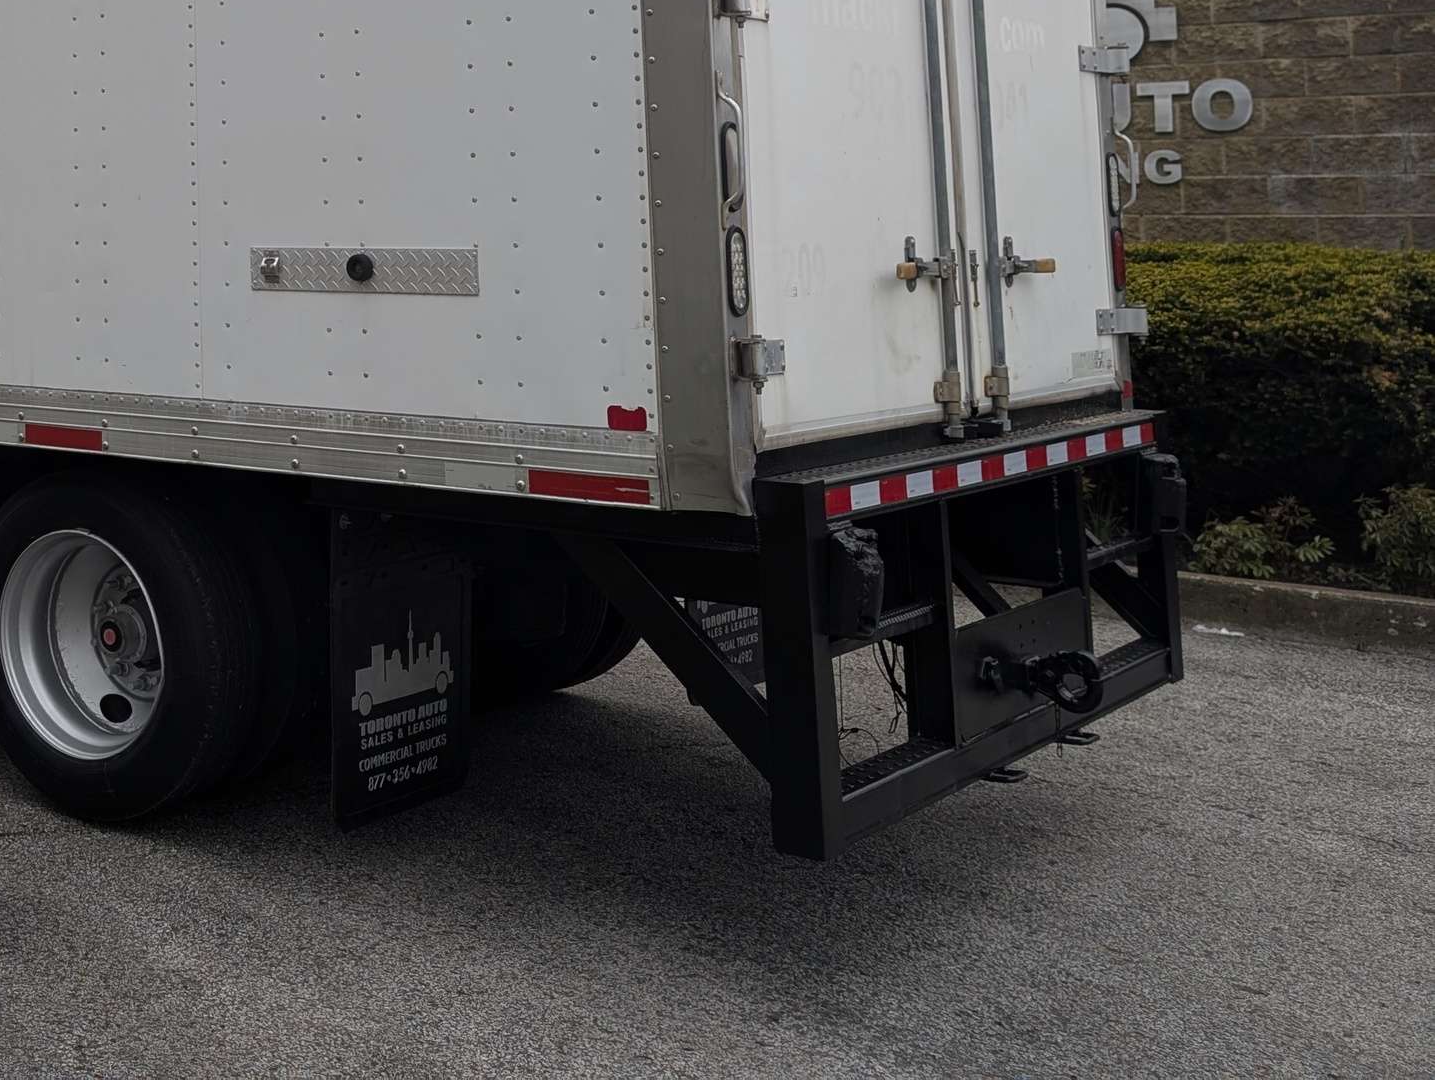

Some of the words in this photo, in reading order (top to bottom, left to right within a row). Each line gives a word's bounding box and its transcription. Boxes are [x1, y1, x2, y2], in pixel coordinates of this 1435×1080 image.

[359, 707, 416, 737] TORONTO
[418, 698, 447, 720] AUTO
[360, 731, 394, 751] SALES
[397, 727, 404, 740] &
[407, 713, 447, 736] LEASING
[359, 744, 414, 773] COMMERCIAL
[415, 732, 447, 755] TRUCKS
